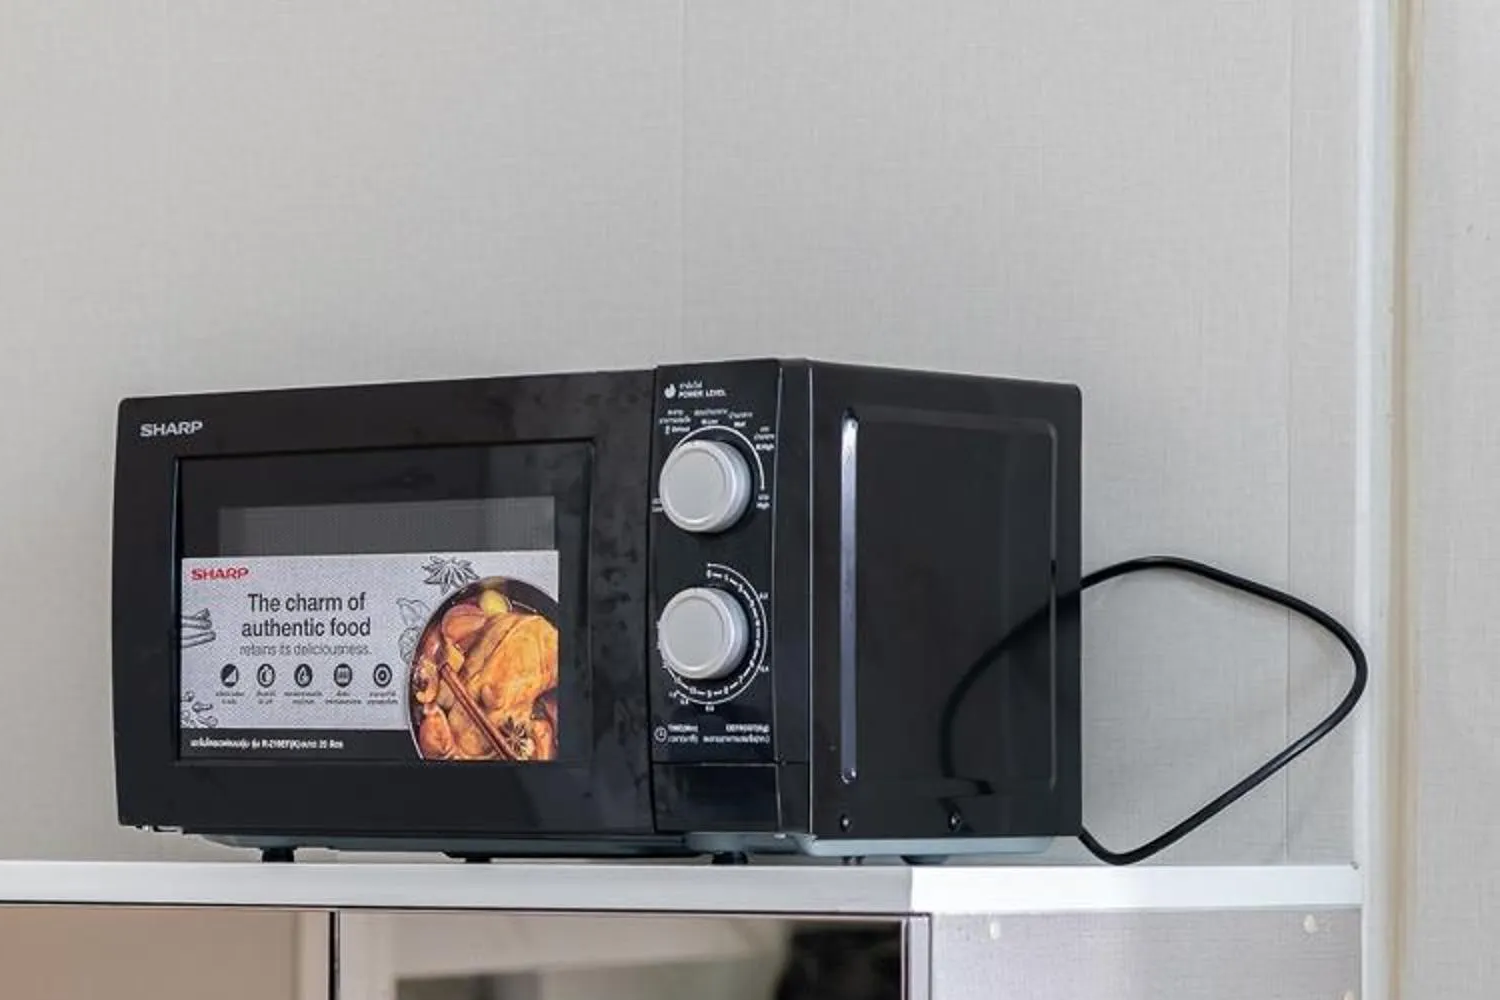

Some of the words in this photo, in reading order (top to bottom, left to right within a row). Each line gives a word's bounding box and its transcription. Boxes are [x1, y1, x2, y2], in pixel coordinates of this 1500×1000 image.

[140, 420, 203, 437] SHARP
[190, 566, 249, 581] SHARP
[247, 592, 281, 612] The
[285, 592, 343, 612] charm
[347, 591, 367, 612] of
[241, 617, 326, 637] authentic
[329, 616, 372, 637] food
[239, 643, 279, 656] retains
